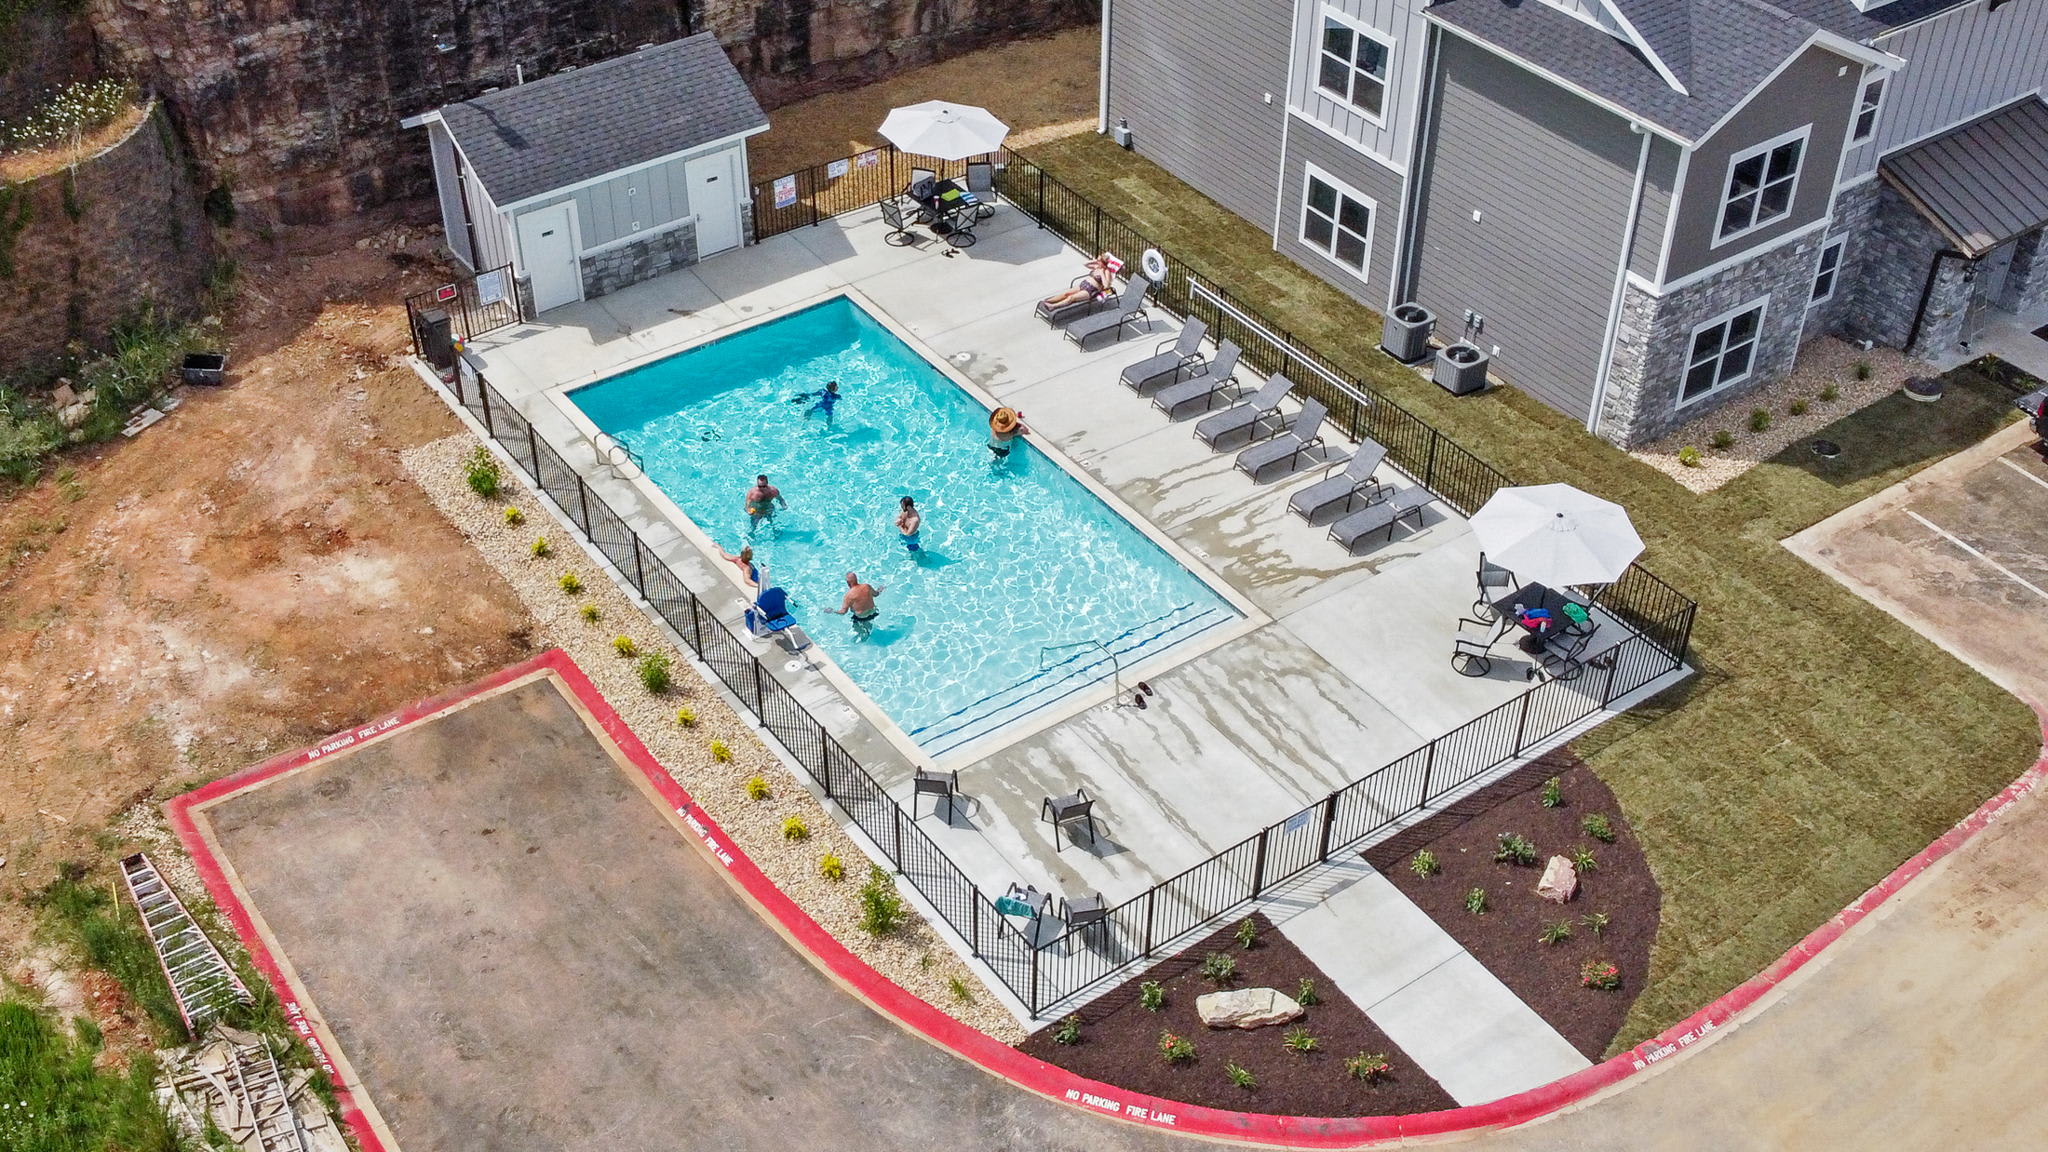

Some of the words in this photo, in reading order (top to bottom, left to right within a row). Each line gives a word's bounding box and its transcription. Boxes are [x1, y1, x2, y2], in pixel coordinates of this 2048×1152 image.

[308, 749, 320, 760] NO
[321, 735, 355, 754] PARKING
[358, 726, 378, 739] FIRE
[378, 716, 400, 731] LANE
[716, 848, 734, 867] LANE
[295, 1020, 312, 1035] FIRE
[1632, 1058, 1646, 1070] NO
[1644, 1043, 1677, 1064] PARKING
[1678, 1031, 1697, 1047] FIRE
[1695, 1020, 1716, 1036] LANE
[1066, 1088, 1080, 1100] NO
[1082, 1093, 1120, 1112] PARKING
[1126, 1105, 1148, 1119] FIRE
[1150, 1110, 1176, 1125] LANE
